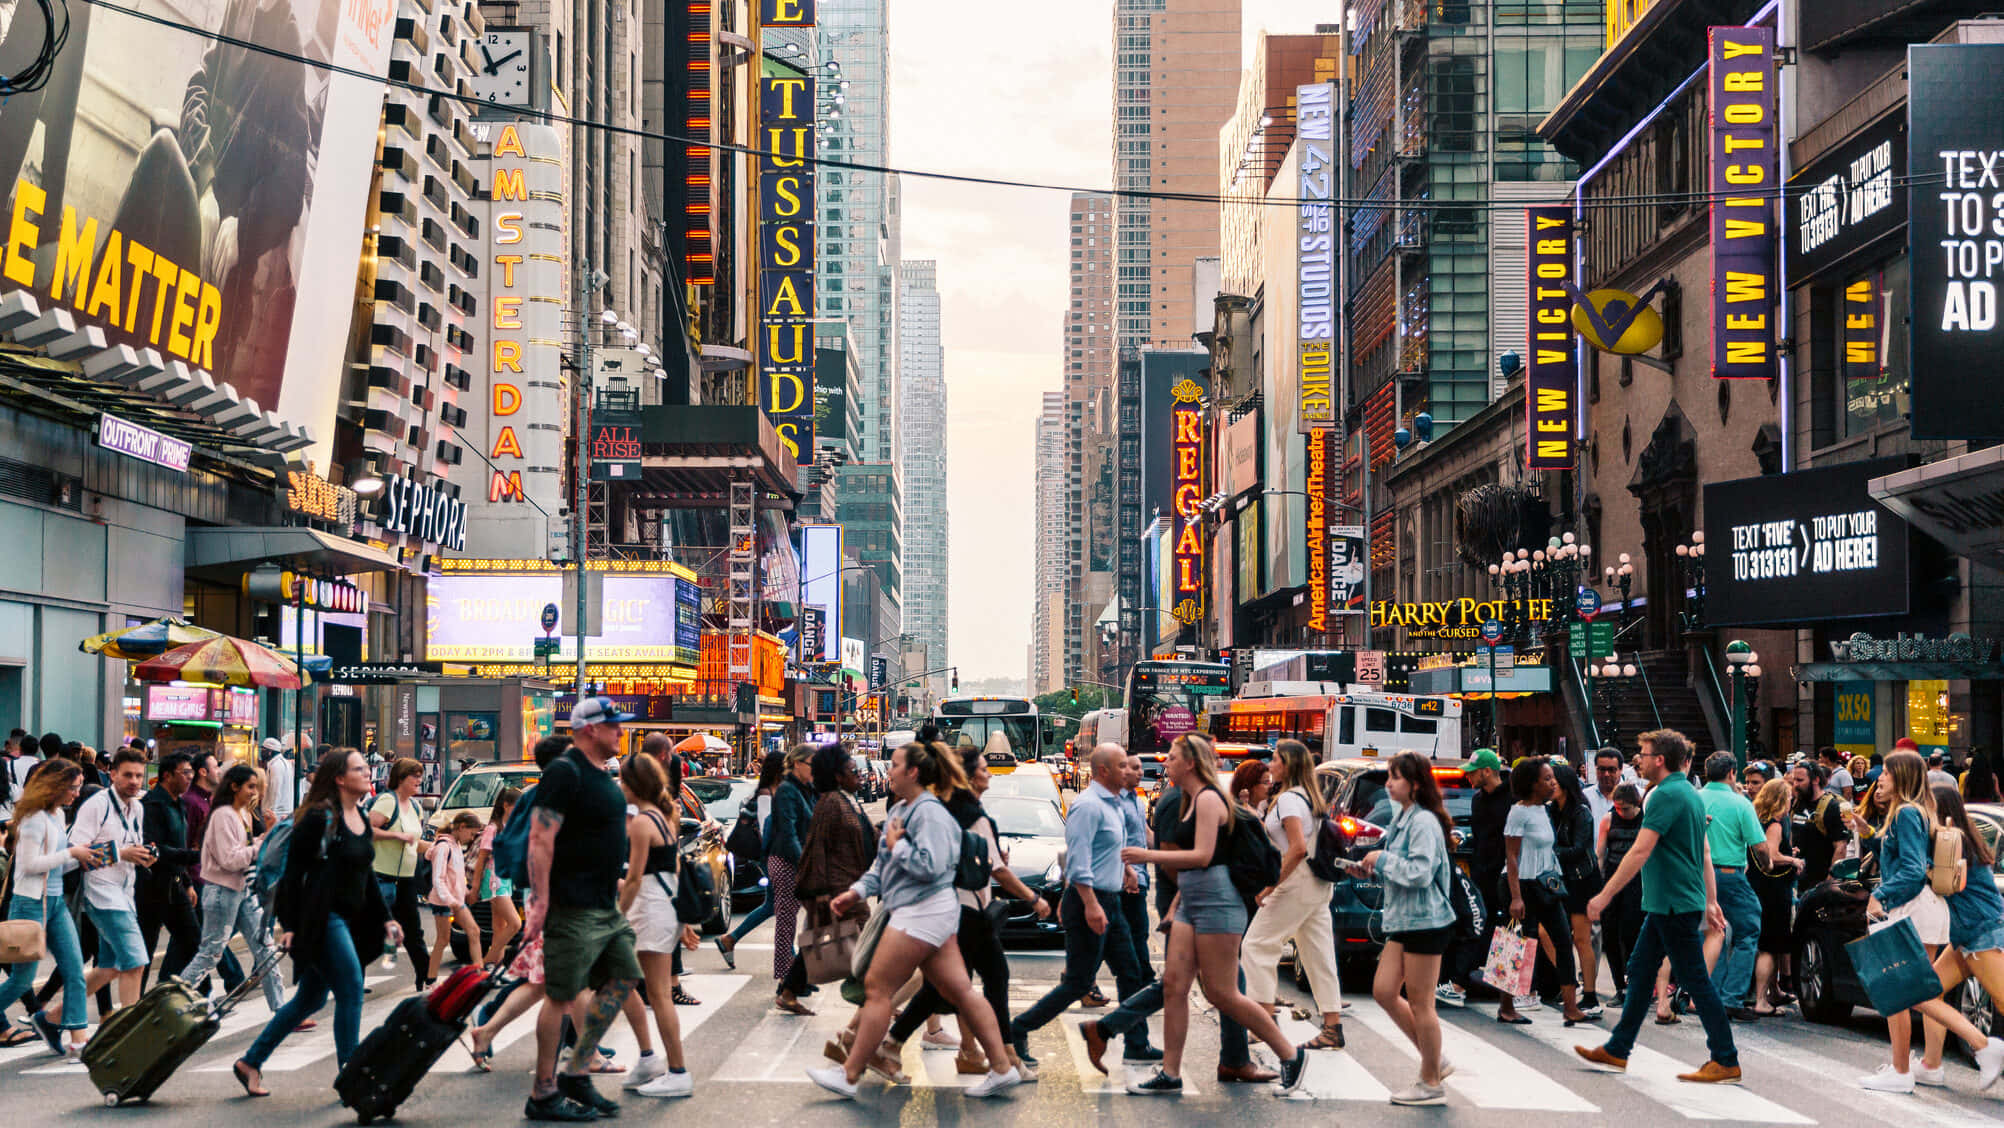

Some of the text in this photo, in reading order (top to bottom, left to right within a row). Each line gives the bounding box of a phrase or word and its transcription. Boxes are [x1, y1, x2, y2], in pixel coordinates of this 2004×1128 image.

[488, 35, 499, 45] 12
[488, 92, 497, 102] 6
[1300, 86, 1330, 199] NEW 42
[1872, 139, 1891, 174] YOUR
[1938, 150, 2004, 189] TEX
[1724, 40, 1766, 364] NEW VICTORY
[1940, 192, 1984, 236] TO
[0, 179, 222, 371] E MATTER
[765, 79, 810, 459] TUSSAUDS
[1940, 239, 2004, 278] TO P
[1300, 236, 1332, 340] STUDIOS
[1942, 281, 1996, 331] AD
[491, 125, 527, 503] AMSTERDAM
[1302, 342, 1330, 350] THE
[1536, 216, 1568, 459] NEW VICTORY
[1302, 351, 1330, 411] DUKE
[103, 419, 189, 467] OUTFRONT PRIME
[593, 442, 642, 458] RISE
[597, 427, 638, 443] ALL
[387, 473, 468, 552] SEPHORA
[1174, 409, 1201, 592] REGAL
[1732, 525, 1761, 551] TEXT
[1812, 510, 1877, 541] TO PUT YOUR
[1331, 541, 1347, 601] DANCE
[1732, 547, 1798, 580] TO 313131
[1812, 535, 1879, 573] AD HERE!
[1370, 600, 1454, 627] HARRY
[1438, 627, 1480, 639] CURSED
[465, 648, 478, 657] AT
[482, 648, 504, 657] 2PM
[560, 648, 593, 657] GRET
[598, 648, 631, 657] SEATS
[804, 611, 815, 657] DANCE
[1360, 669, 1381, 681] 25
[1514, 655, 1544, 665] TORY
[179, 703, 206, 717] GIRLS
